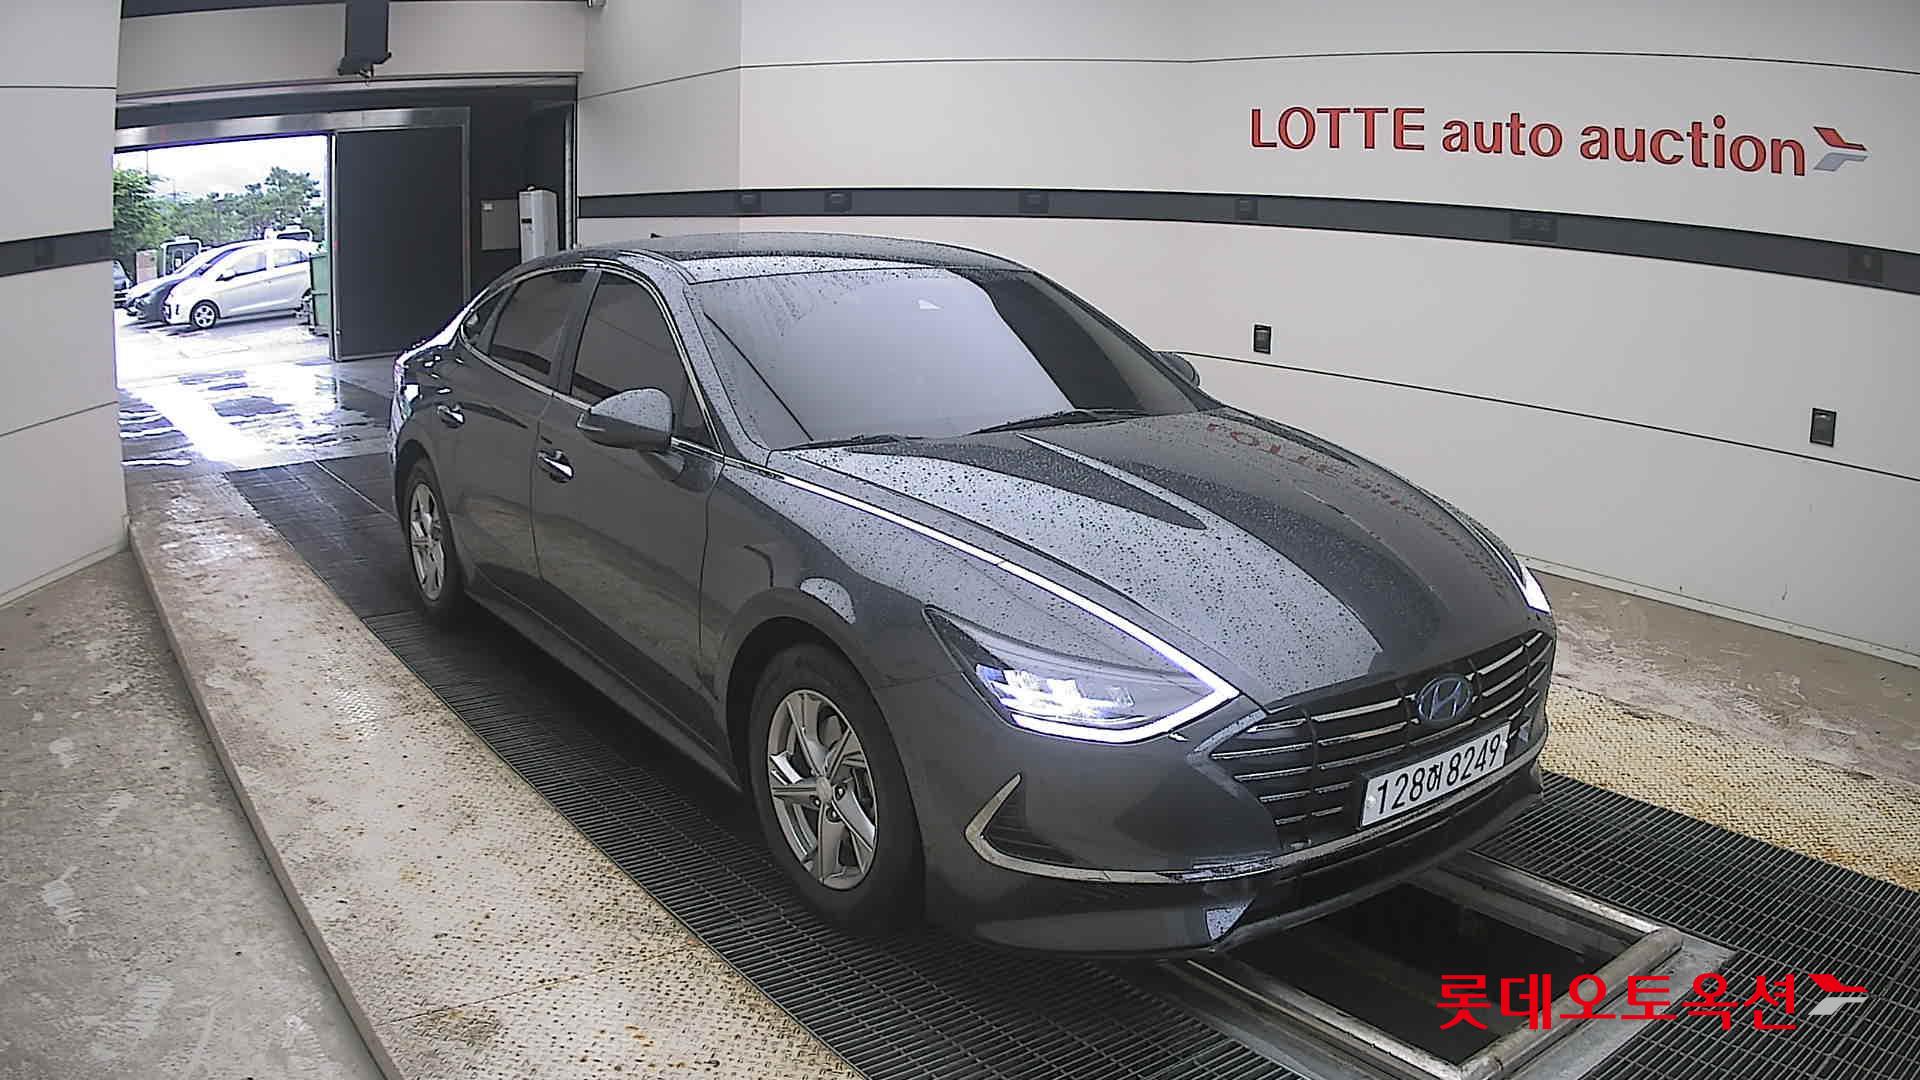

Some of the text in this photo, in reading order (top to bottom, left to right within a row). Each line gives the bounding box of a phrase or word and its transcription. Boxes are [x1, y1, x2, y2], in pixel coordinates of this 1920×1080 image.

[1249, 106, 1806, 177] LOTTE auto auction
